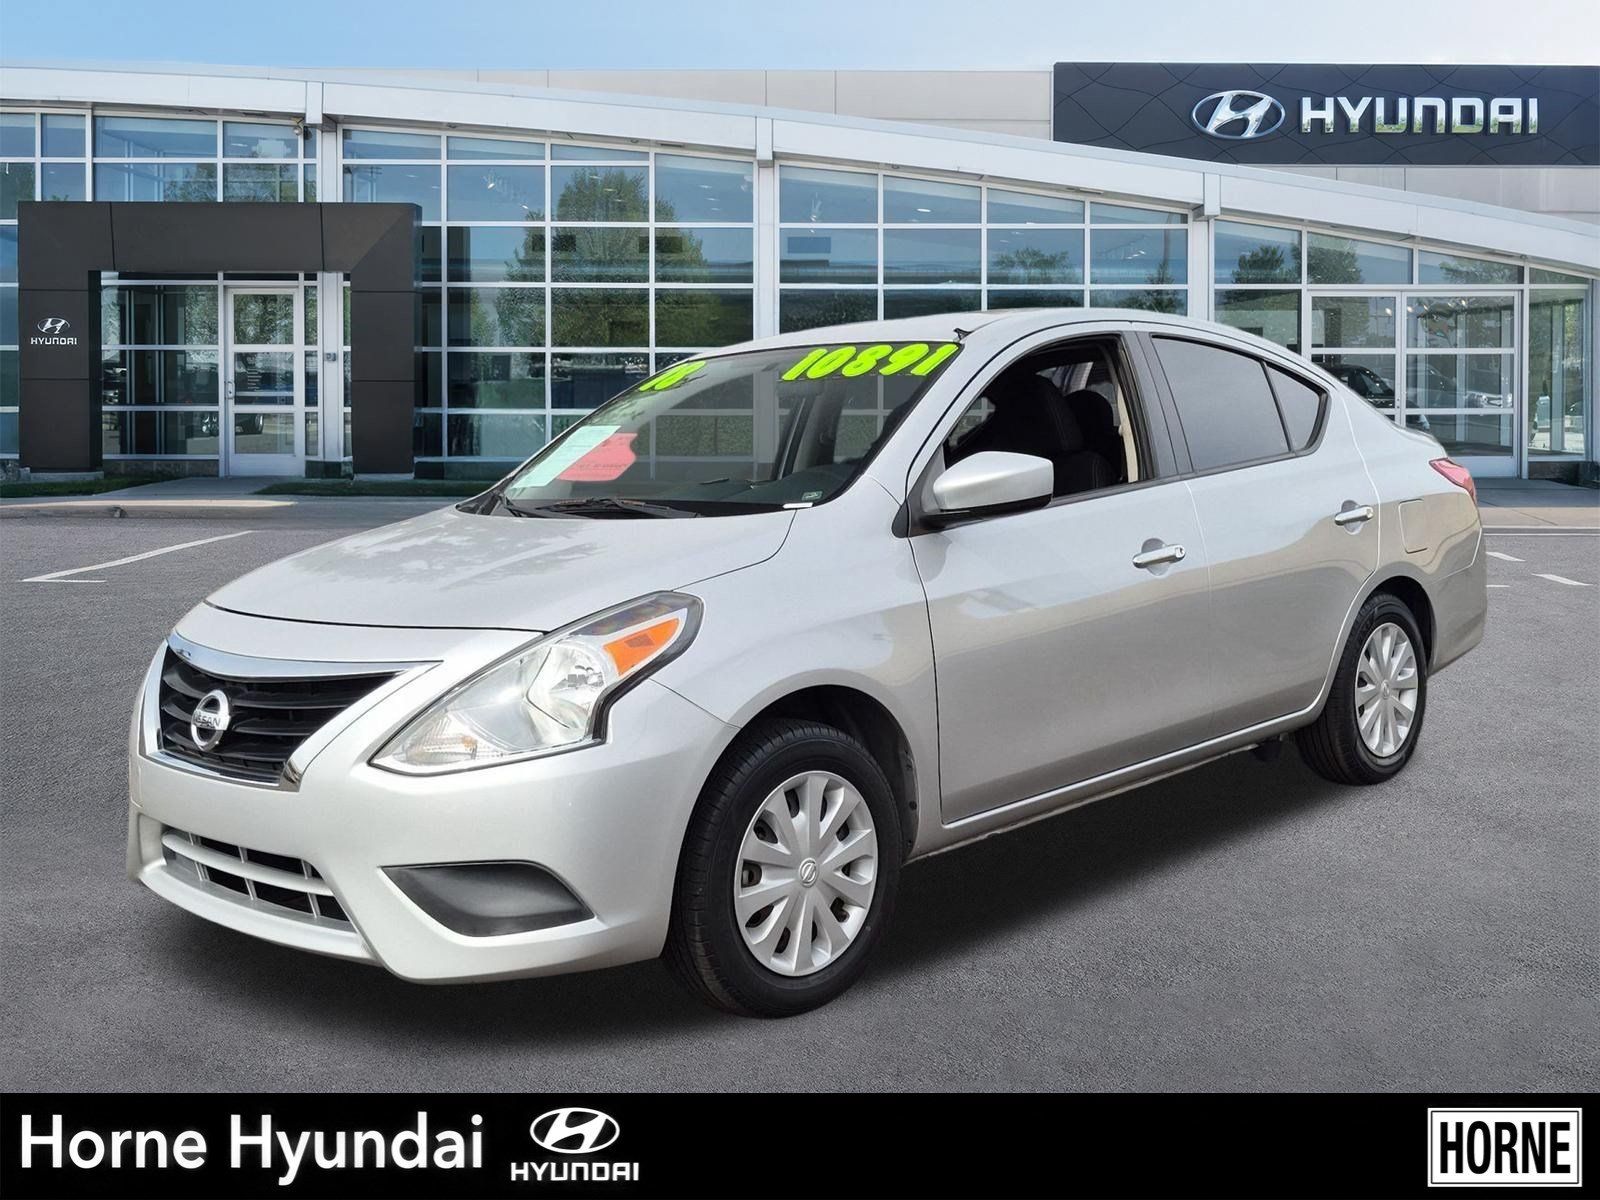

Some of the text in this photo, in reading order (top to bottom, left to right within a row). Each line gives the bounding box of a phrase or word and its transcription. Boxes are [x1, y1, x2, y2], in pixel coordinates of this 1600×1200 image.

[1301, 97, 1538, 134] HYUNDAI
[30, 337, 78, 346] HYUNDAI
[781, 343, 958, 381] 10891
